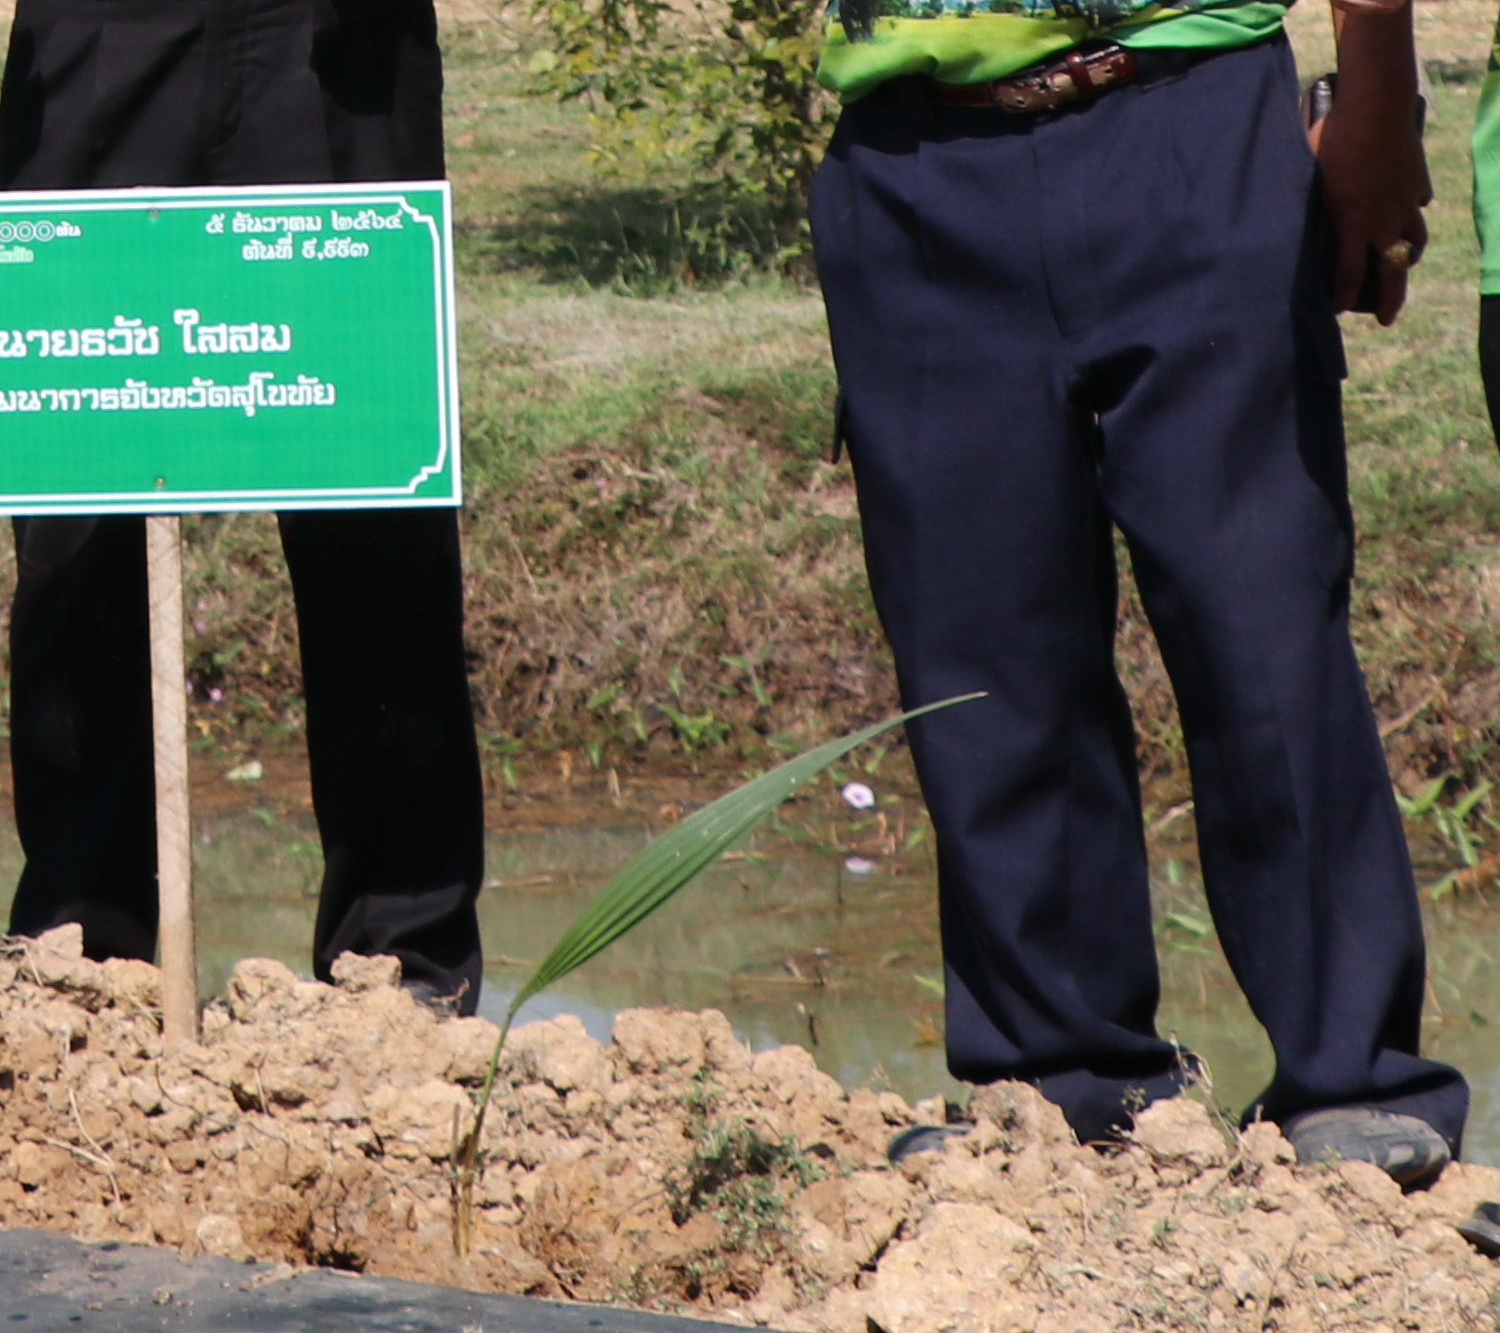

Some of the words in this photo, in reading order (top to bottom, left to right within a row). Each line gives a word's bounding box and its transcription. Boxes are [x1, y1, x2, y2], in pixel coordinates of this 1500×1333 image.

[231, 210, 323, 236] ธันวาคม
[330, 208, 405, 232] ๒๕๖๔
[241, 232, 294, 262] ต้นที่
[173, 307, 292, 355] ใสสม
